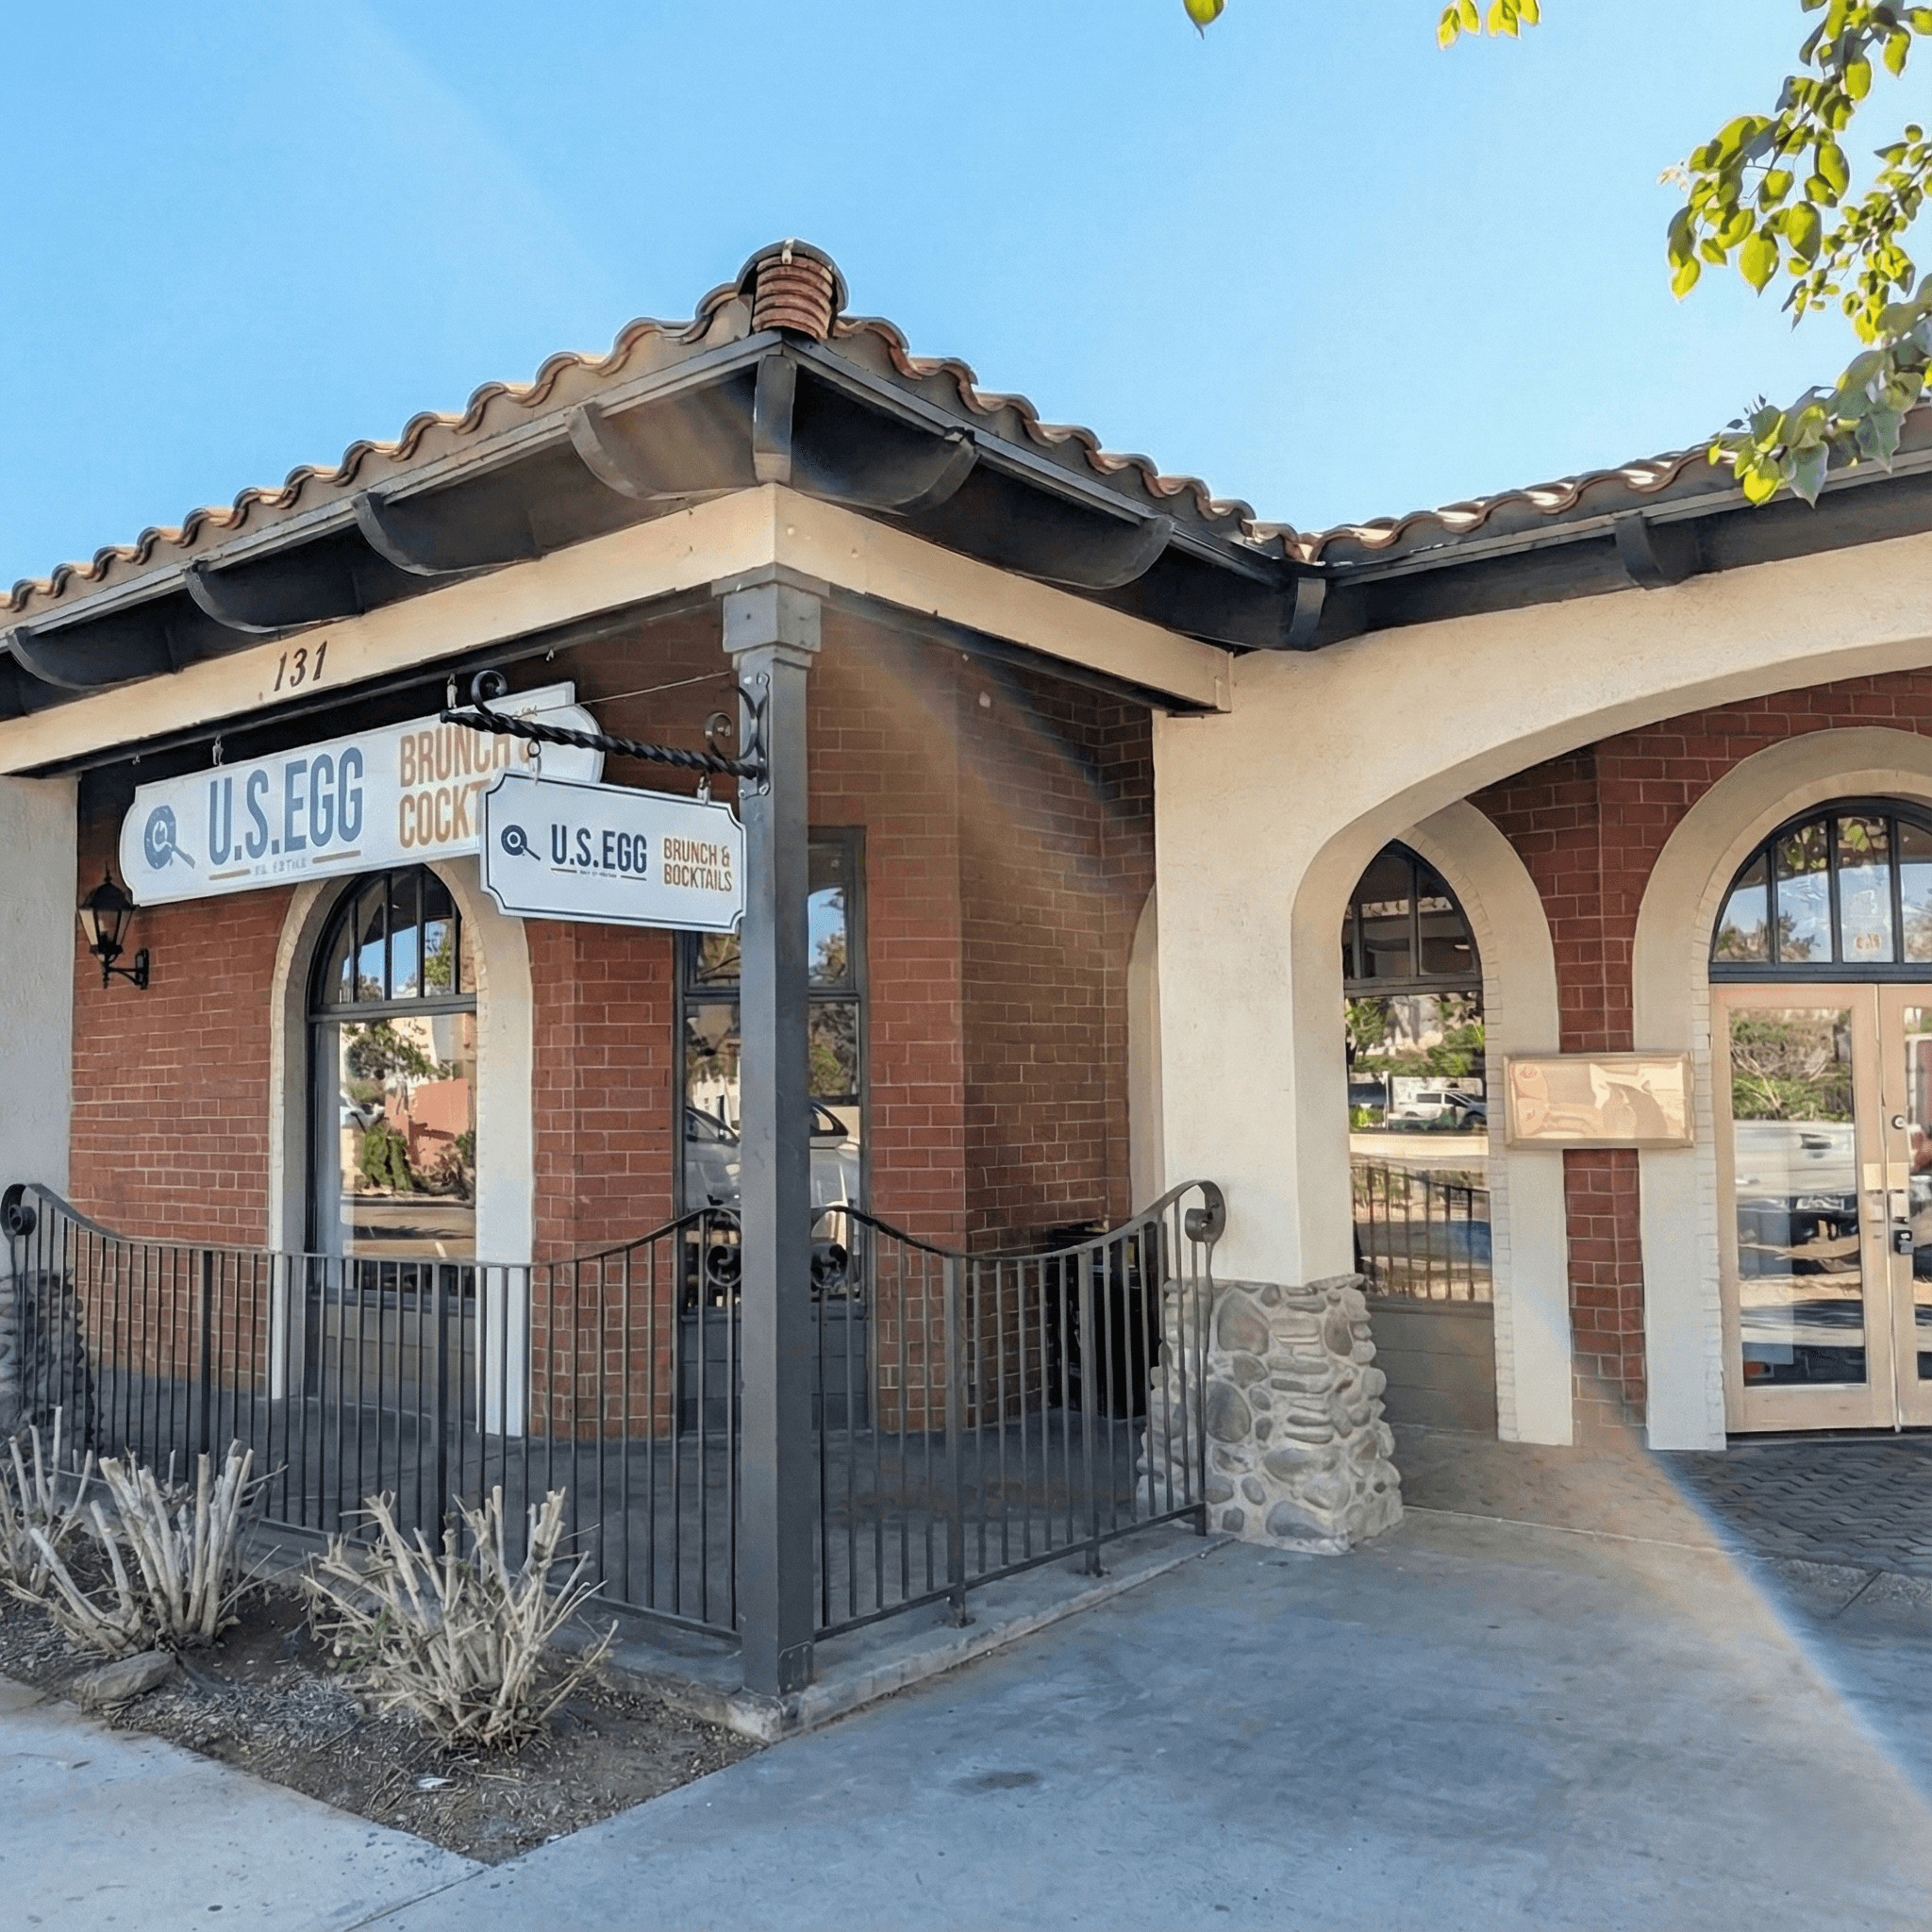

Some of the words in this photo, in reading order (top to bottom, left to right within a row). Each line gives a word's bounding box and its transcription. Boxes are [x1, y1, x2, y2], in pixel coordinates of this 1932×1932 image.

[274, 640, 327, 691] 131
[399, 778, 491, 849] COCKT
[663, 837, 717, 867] BRUNCH
[721, 845, 730, 868] &
[663, 863, 732, 892] BOCKTAILS
